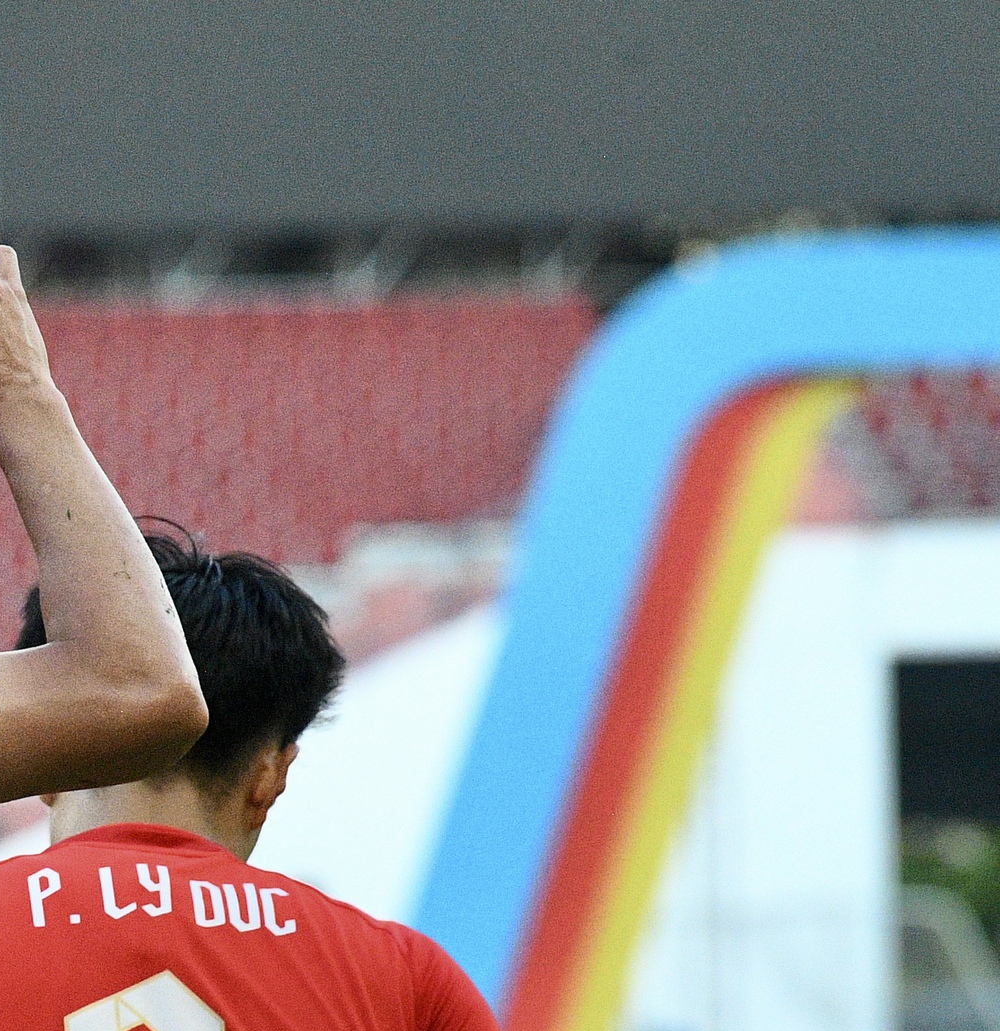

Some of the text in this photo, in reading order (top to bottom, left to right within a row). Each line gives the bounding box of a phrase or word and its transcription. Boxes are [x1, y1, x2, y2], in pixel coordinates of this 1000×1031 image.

[27, 863, 297, 936] P. LY DUC
